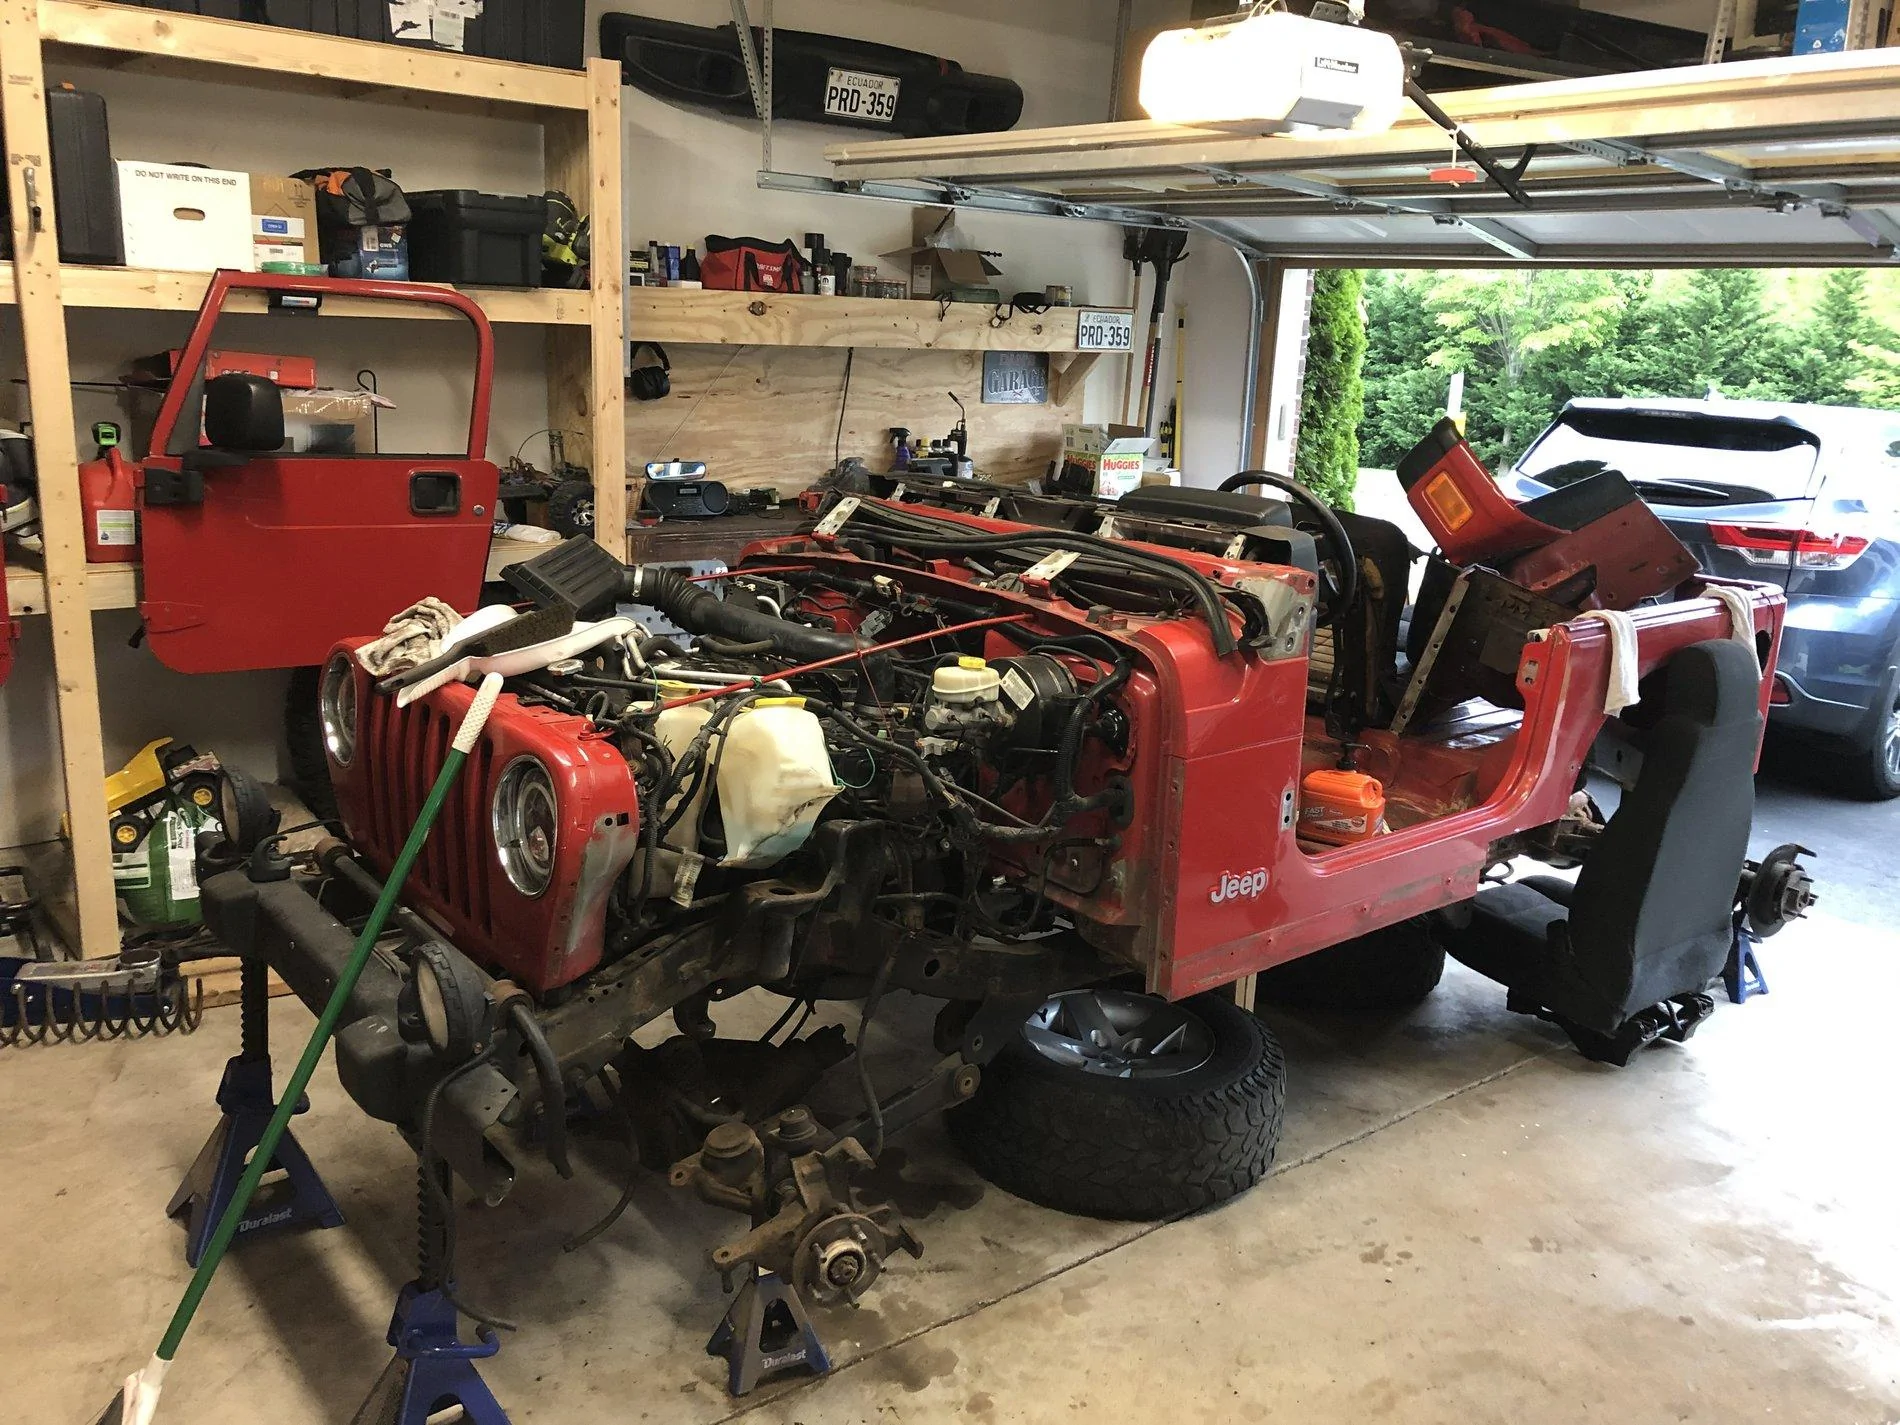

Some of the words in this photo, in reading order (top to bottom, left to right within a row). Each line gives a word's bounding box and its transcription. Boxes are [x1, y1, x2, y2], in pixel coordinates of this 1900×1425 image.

[847, 75, 884, 90] ECUADOR
[827, 86, 895, 117] PRD-359
[135, 169, 147, 178] DO
[148, 171, 164, 180] NOT
[166, 172, 190, 182] WRITE
[191, 175, 203, 184] ON
[204, 176, 221, 185] THIS
[221, 178, 237, 187] END
[1093, 314, 1120, 324] ECUADOR
[1081, 325, 1130, 347] PRD-359
[987, 368, 1046, 394] GARAGE
[1210, 870, 1267, 903] Jeep
[239, 1207, 292, 1233] Duralast
